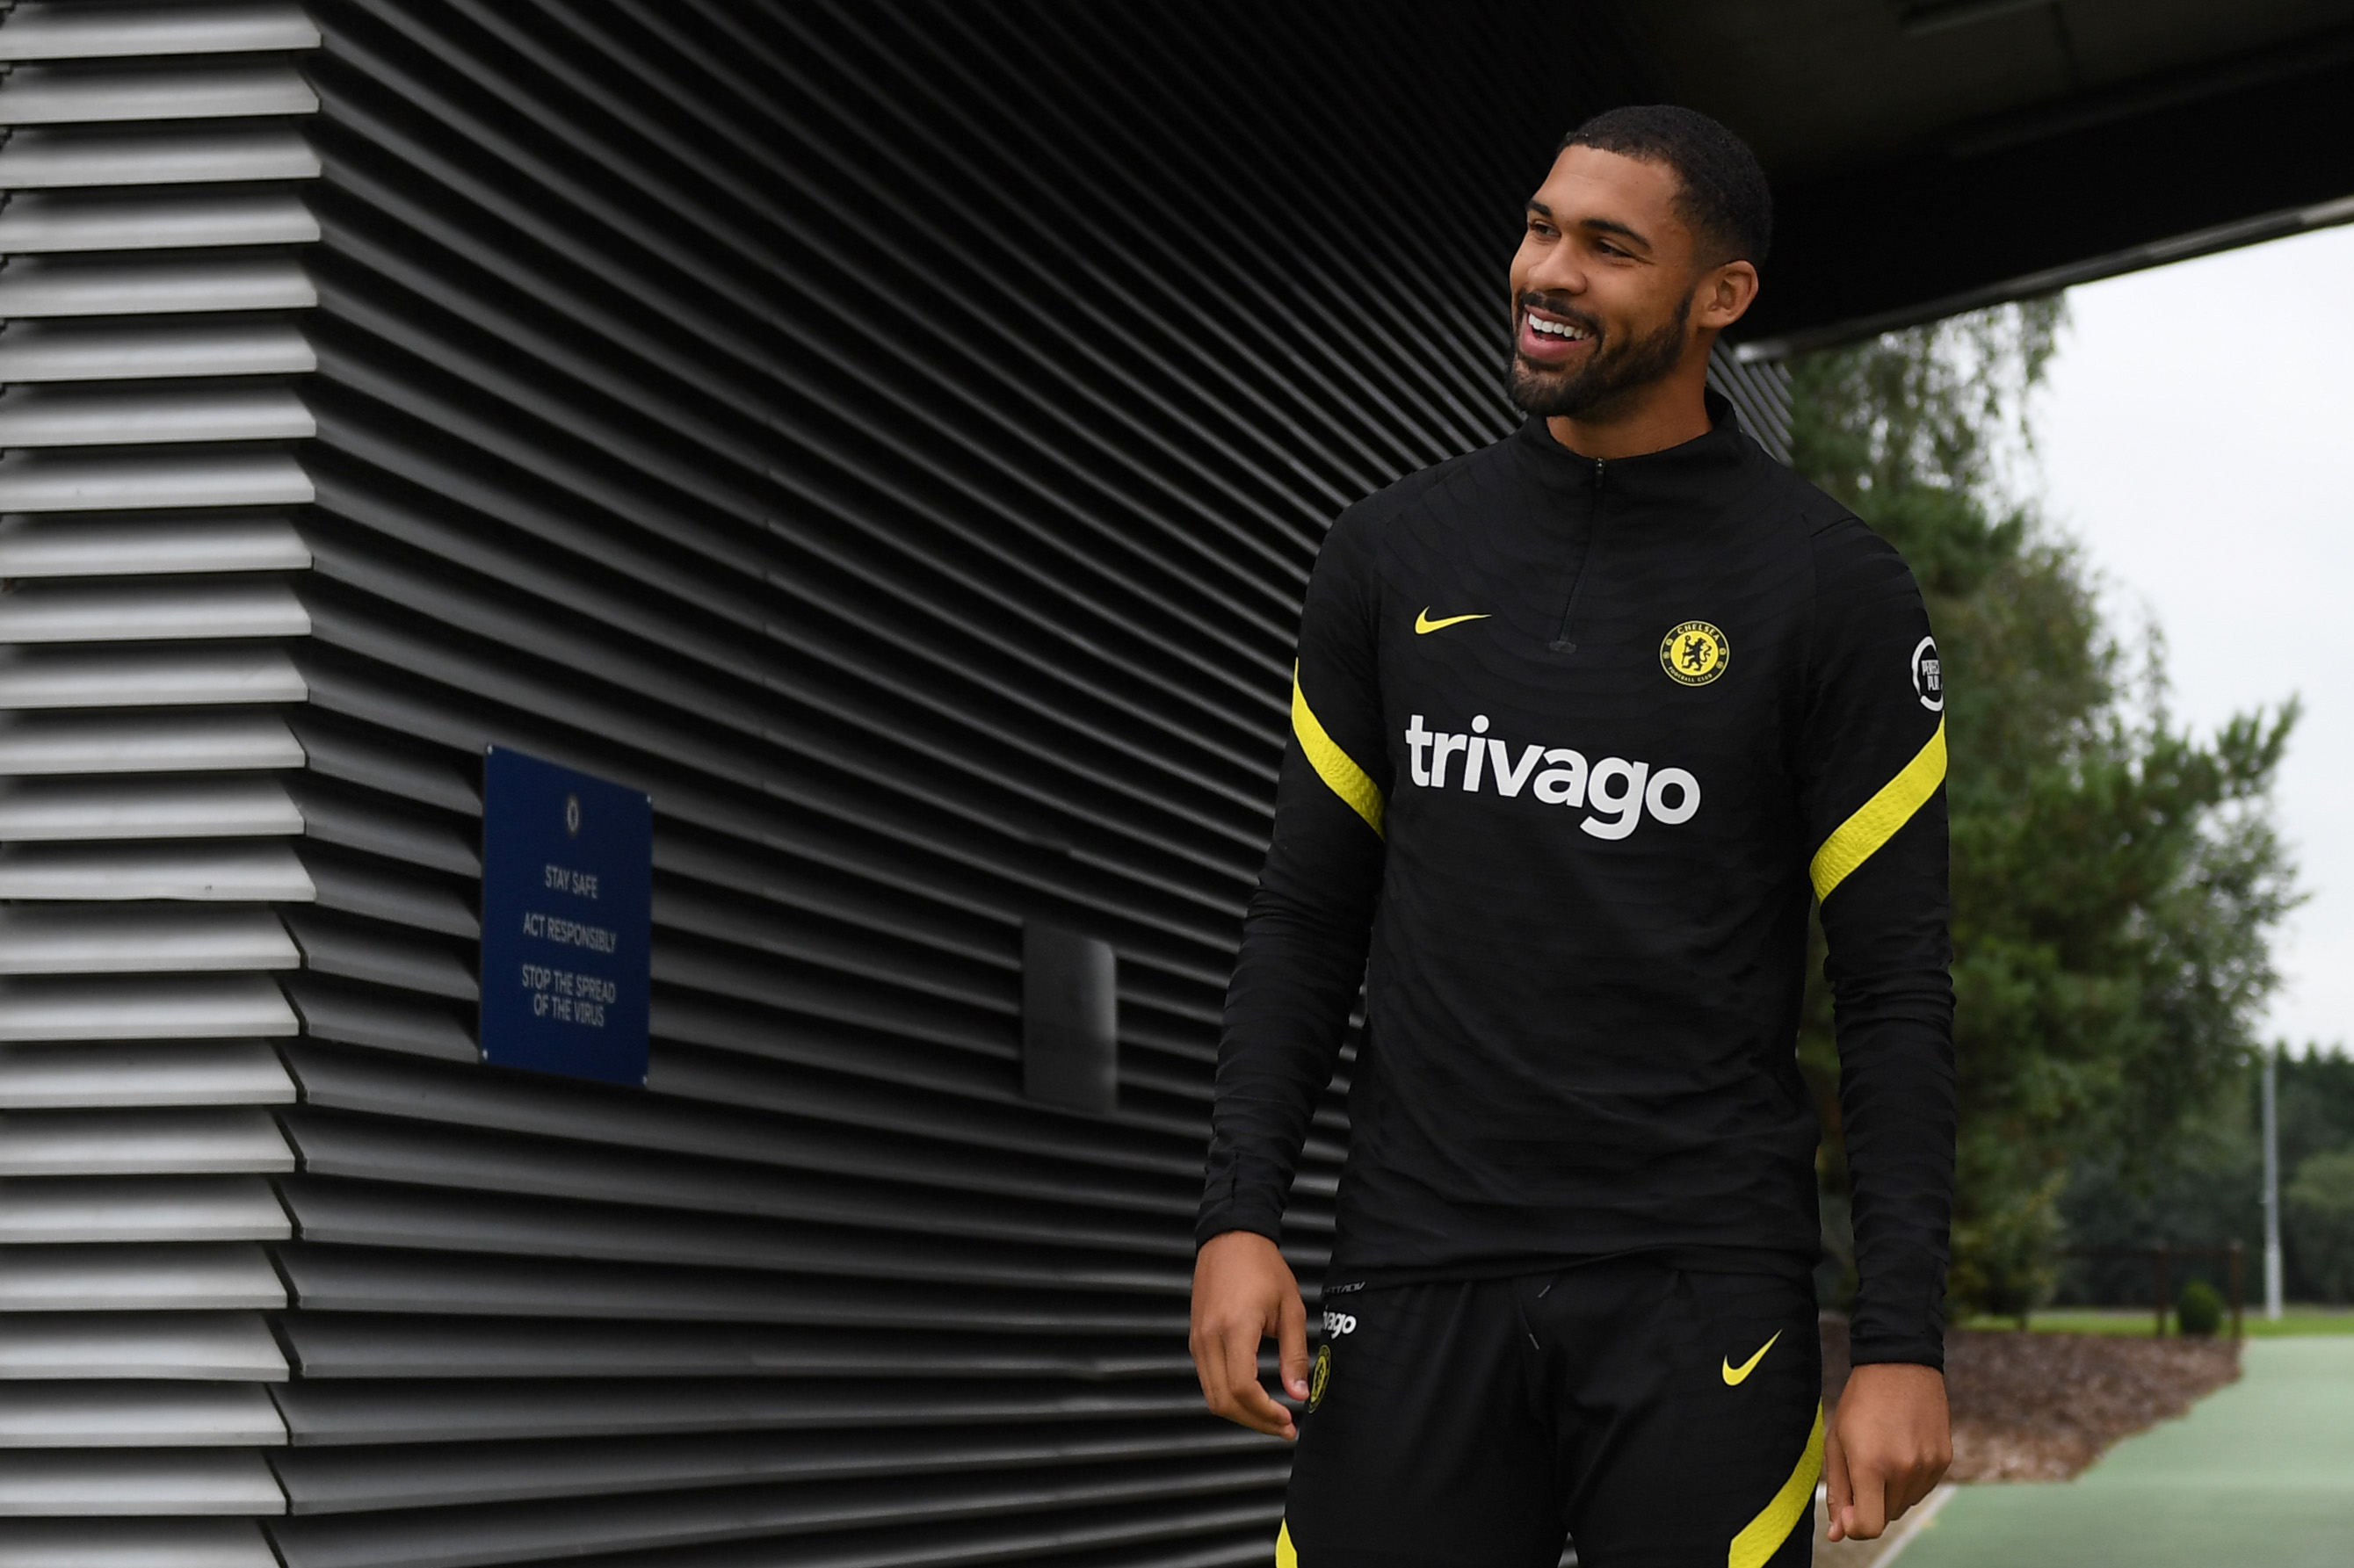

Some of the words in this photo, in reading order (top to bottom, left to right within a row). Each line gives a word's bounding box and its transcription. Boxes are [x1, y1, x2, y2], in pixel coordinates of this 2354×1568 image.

[1677, 624, 1720, 640] CHELSEA
[1405, 714, 1701, 841] trivago
[545, 864, 570, 892] STAY
[572, 871, 598, 899] SAFE
[523, 912, 546, 938] ACT
[547, 916, 617, 953] RESPONSIBLY
[522, 965, 551, 990] STOP
[554, 970, 573, 996] THE
[576, 974, 617, 1004] SPREAD
[533, 993, 549, 1016] OF
[551, 996, 571, 1022] THE
[574, 1001, 605, 1027] VIRUS
